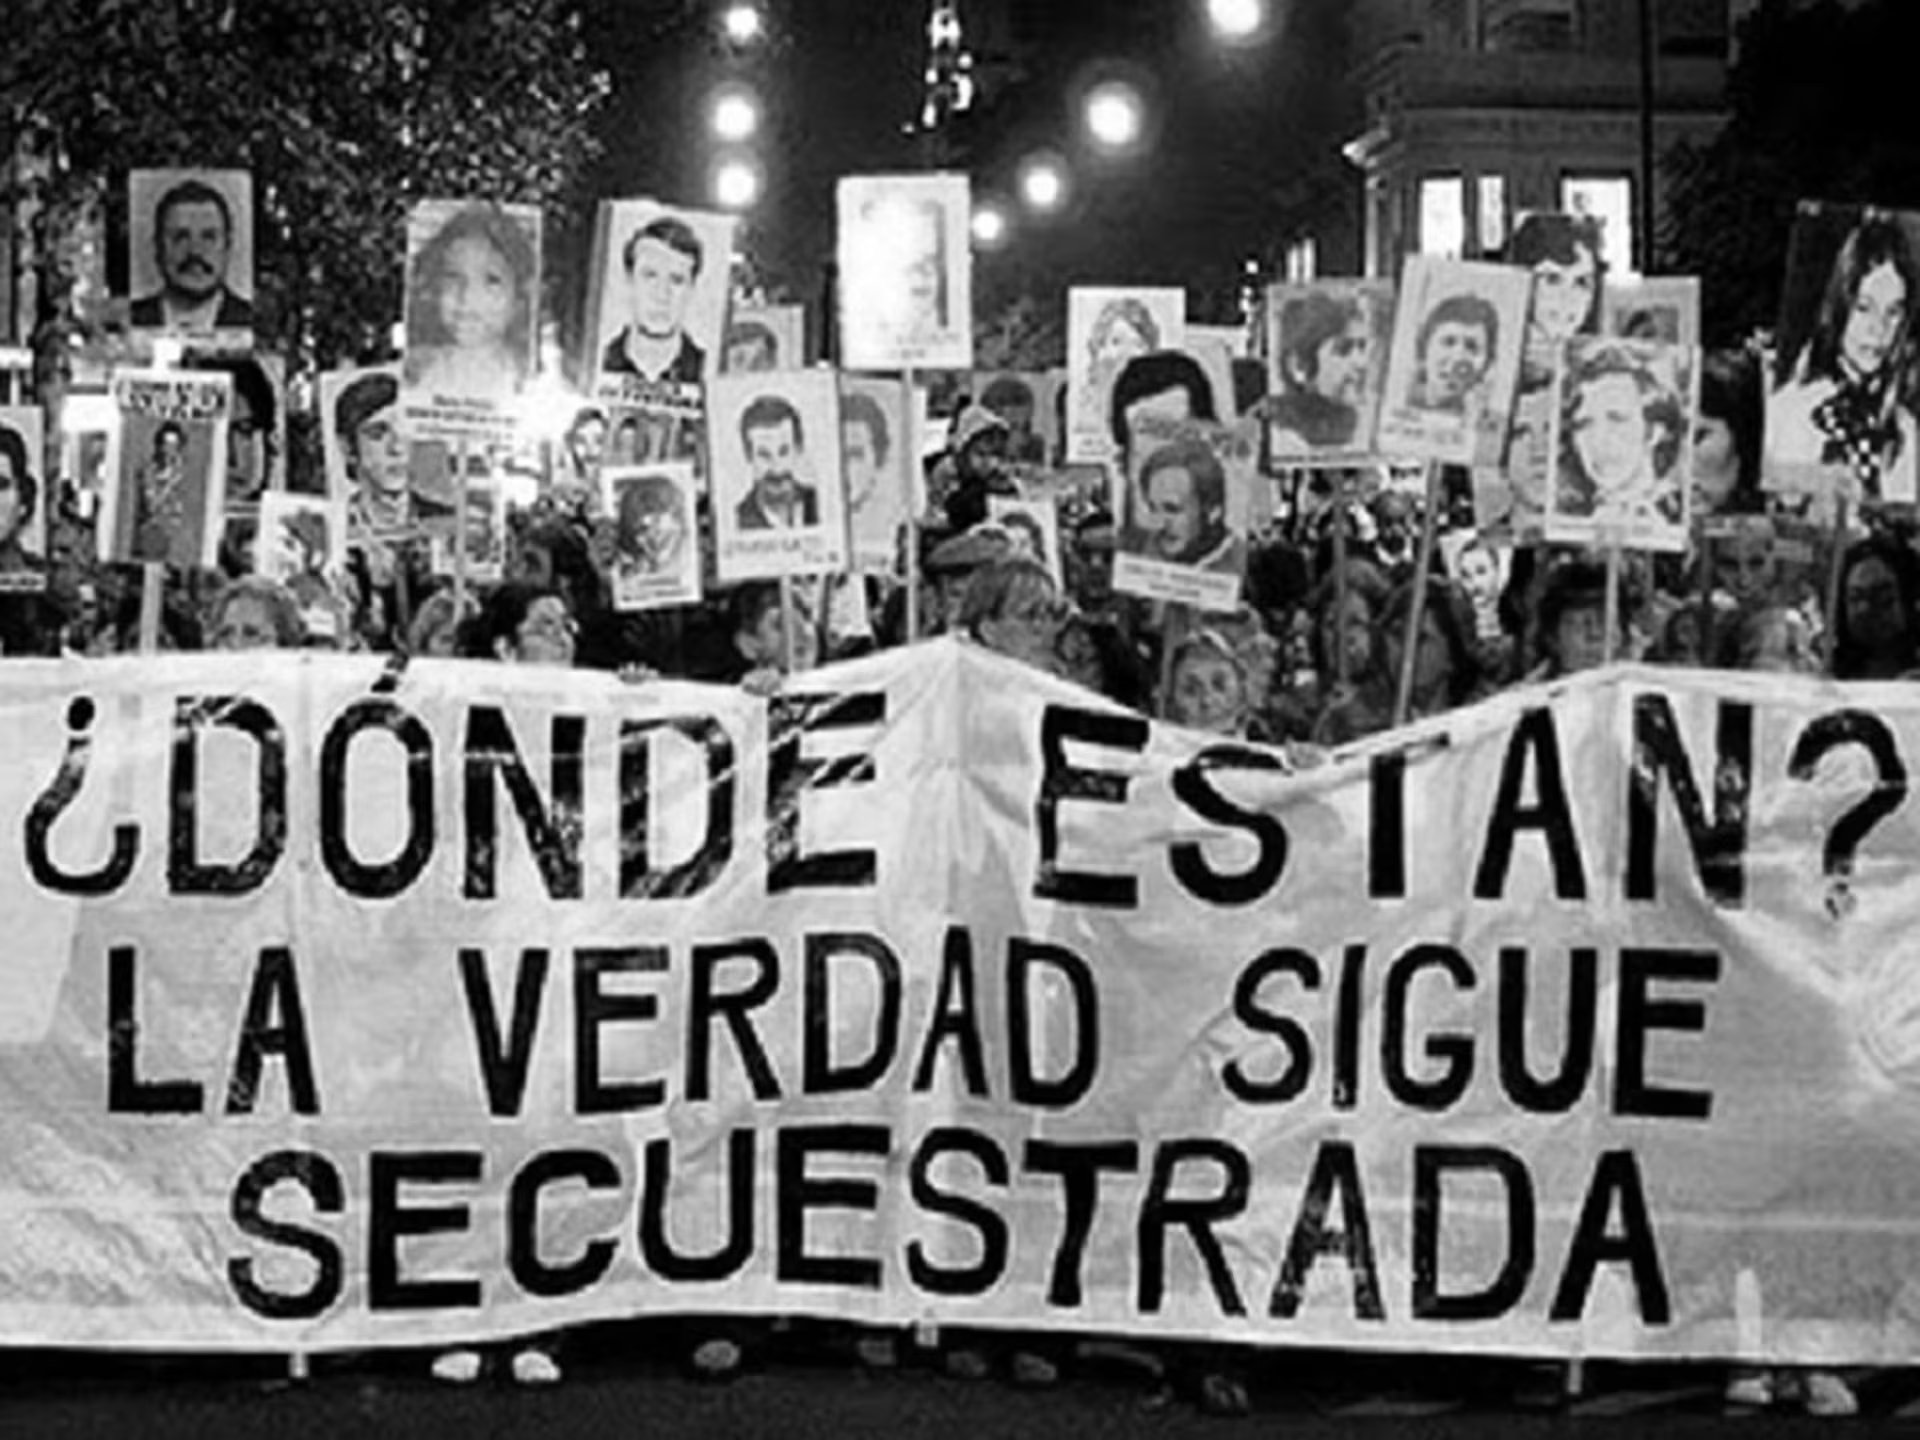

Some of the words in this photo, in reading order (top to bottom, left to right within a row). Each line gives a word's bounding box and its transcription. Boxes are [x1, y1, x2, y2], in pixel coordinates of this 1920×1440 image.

[108, 946, 320, 1115] LA
[458, 926, 1100, 1116] VERDAD
[1221, 944, 1721, 1118] SIGUE
[227, 1126, 1670, 1325] SECUESTRADA
